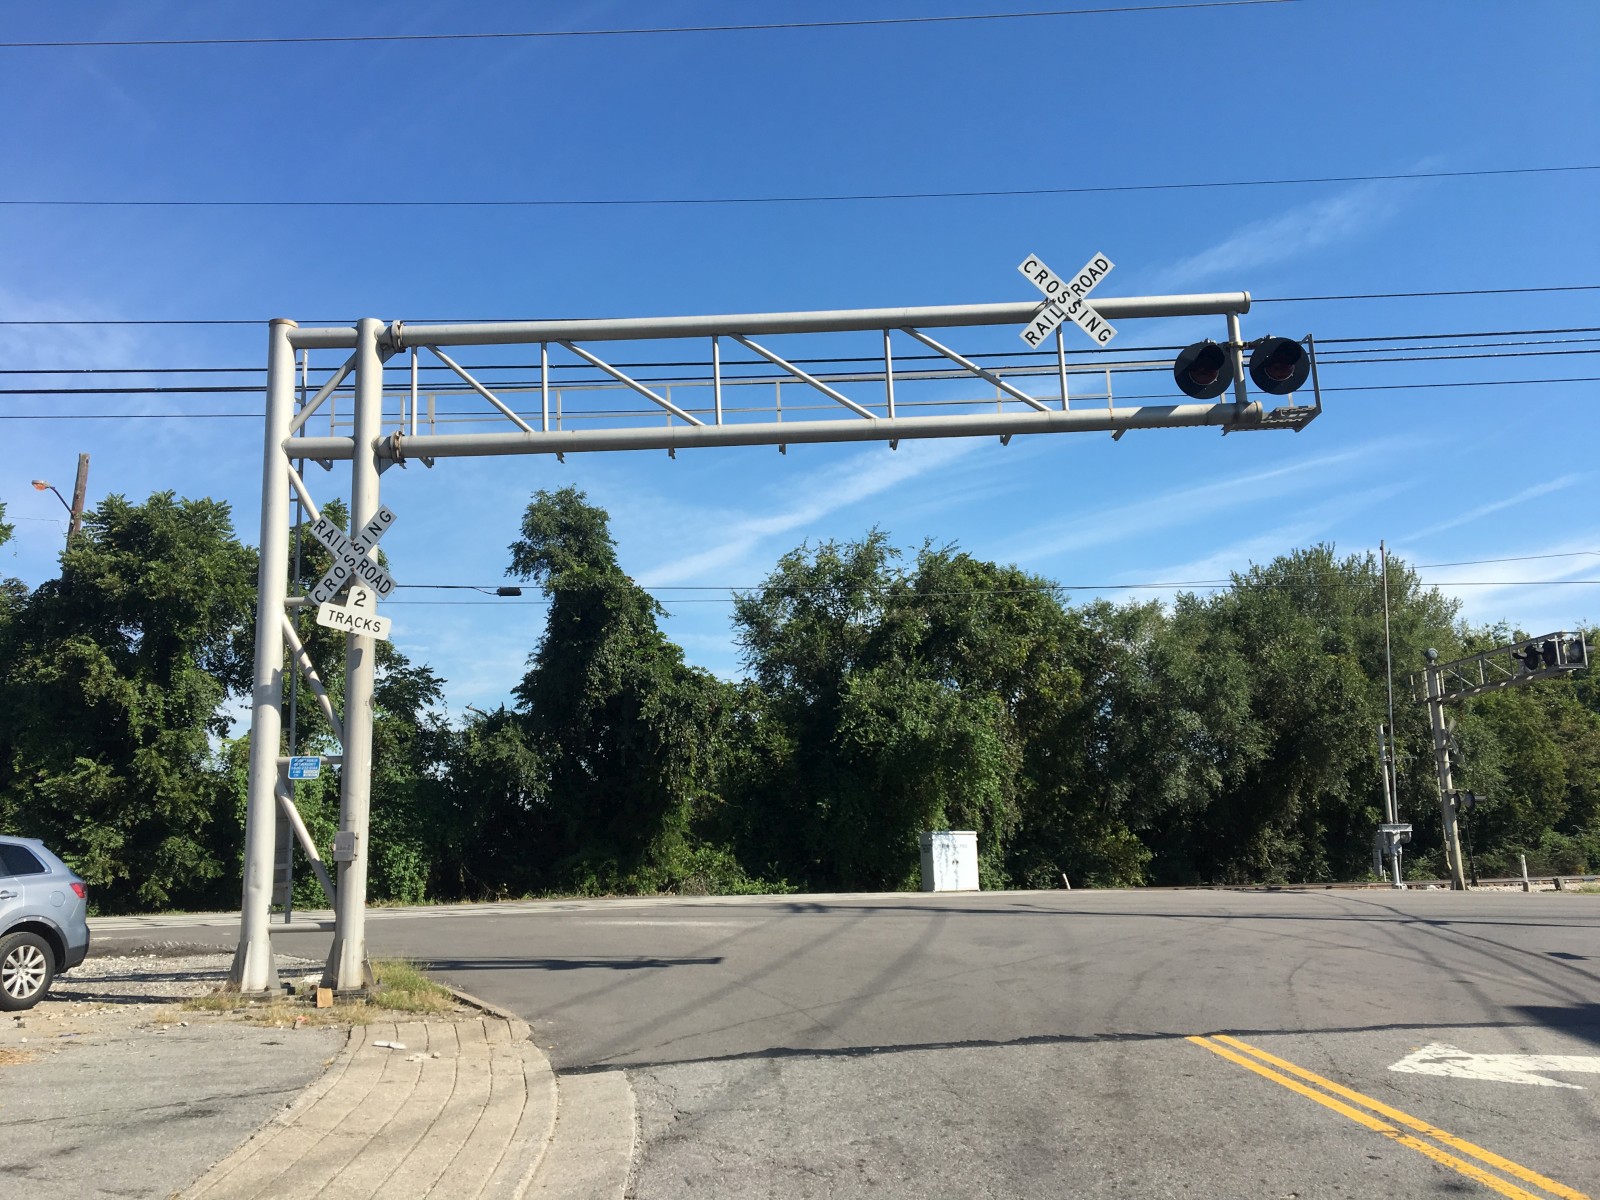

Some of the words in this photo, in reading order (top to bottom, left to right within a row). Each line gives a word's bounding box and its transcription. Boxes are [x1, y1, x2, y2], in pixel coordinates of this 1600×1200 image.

[1023, 260, 1112, 343] CROSSING
[314, 510, 392, 603] CROSSING
[328, 609, 382, 633] TRACKS
[353, 591, 367, 608] 2
